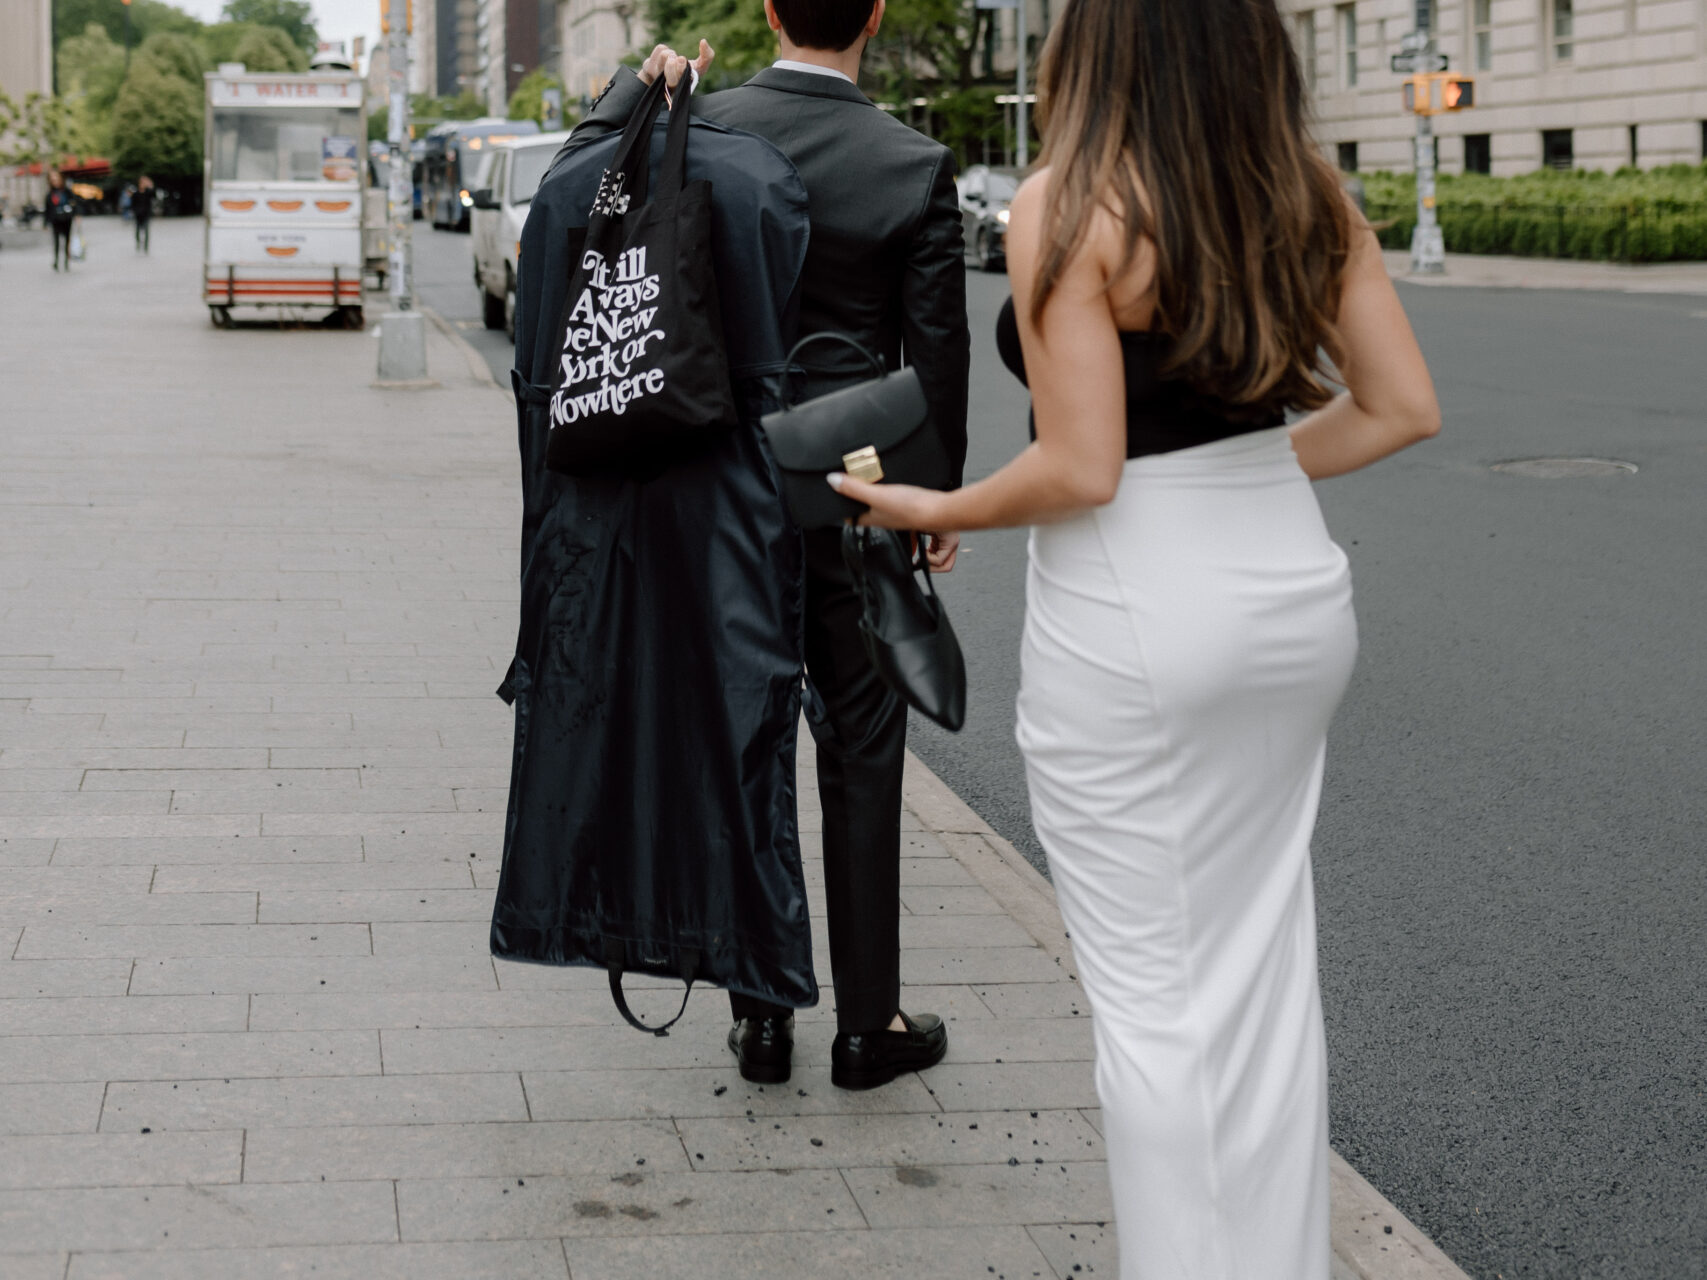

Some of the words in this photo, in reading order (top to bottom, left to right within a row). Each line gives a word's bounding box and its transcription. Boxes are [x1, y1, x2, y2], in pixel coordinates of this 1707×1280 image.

[582, 249, 611, 290] It
[588, 306, 658, 347] New
[621, 329, 666, 364] or
[549, 368, 665, 430] Nowhere
